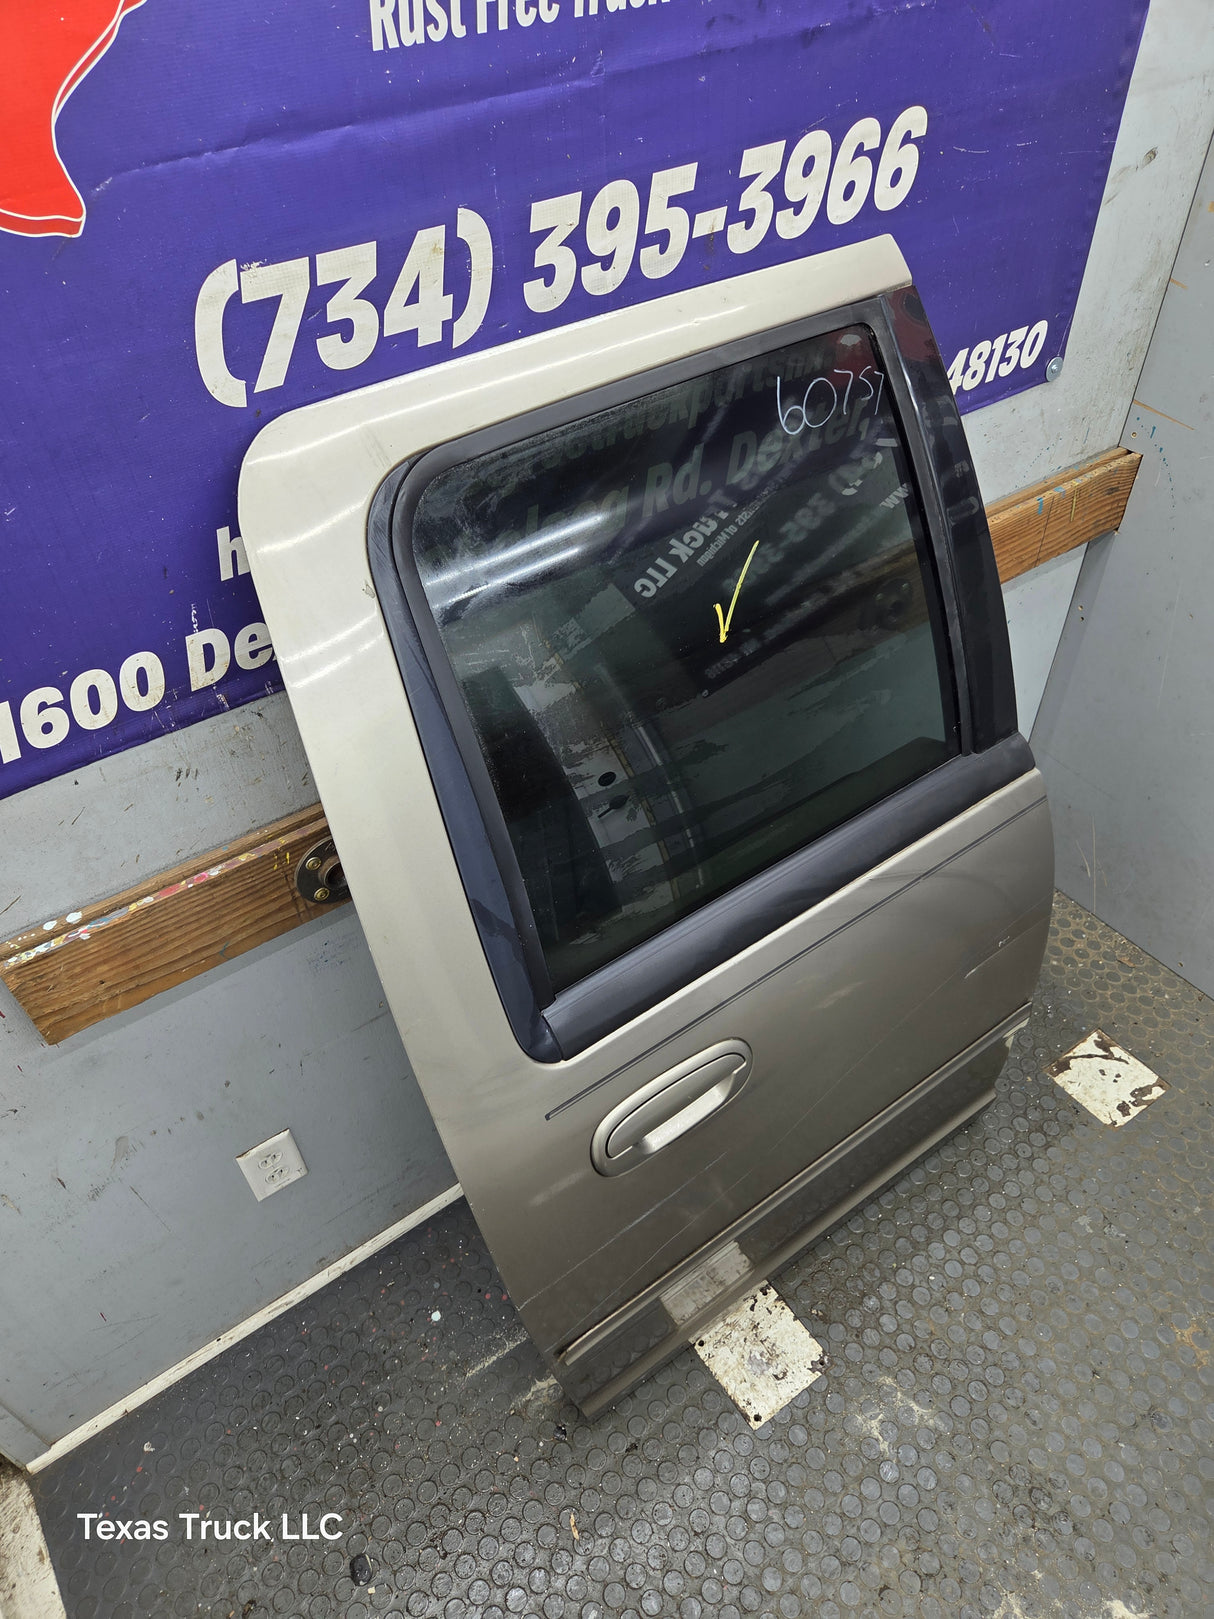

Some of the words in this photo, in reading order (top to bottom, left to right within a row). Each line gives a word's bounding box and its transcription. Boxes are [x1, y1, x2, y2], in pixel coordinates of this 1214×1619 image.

[195, 207, 493, 407] (734)
[523, 105, 928, 312] 395-3966
[185, 622, 278, 692] De
[946, 319, 1048, 396] 48130
